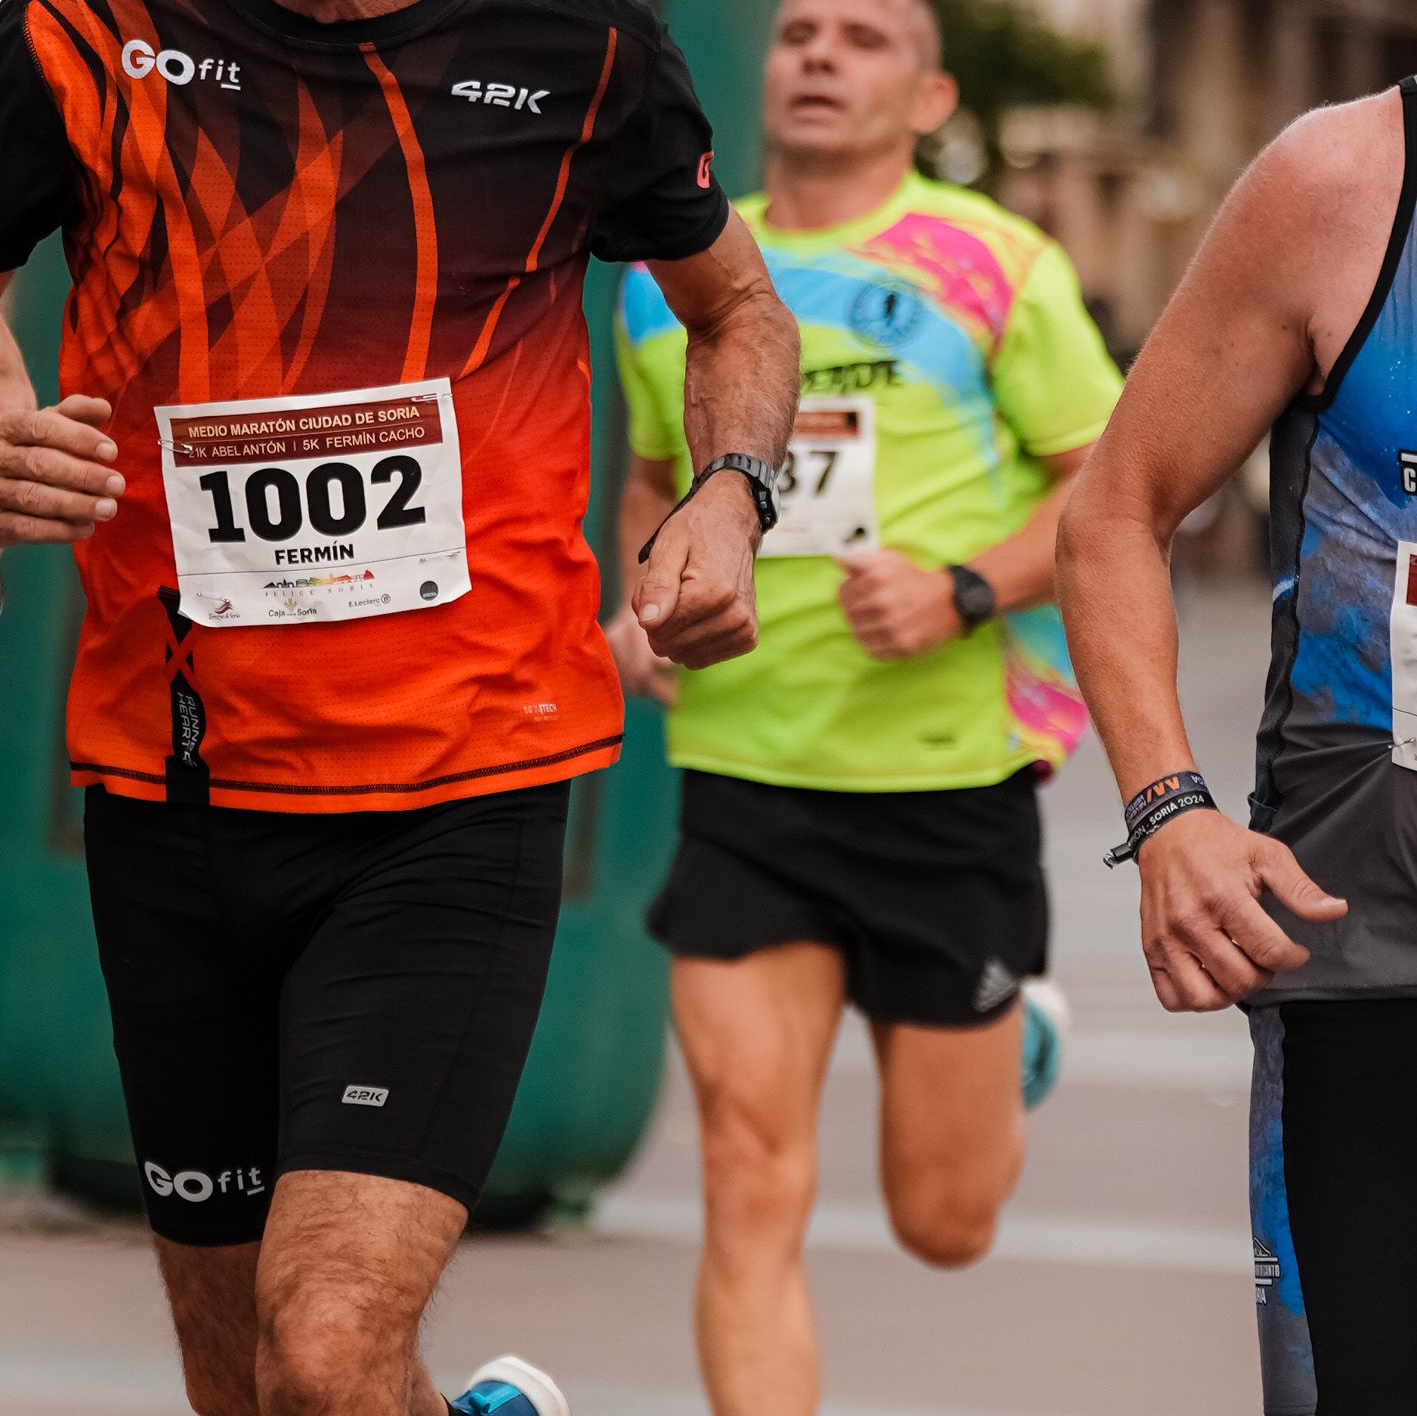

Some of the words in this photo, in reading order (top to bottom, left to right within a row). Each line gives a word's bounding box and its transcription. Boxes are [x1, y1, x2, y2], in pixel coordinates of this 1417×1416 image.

[451, 81, 551, 115] 42K
[188, 425, 229, 439] MEDIO
[230, 417, 295, 435] MARATÓN
[299, 414, 353, 431] CIUDAD
[355, 411, 373, 425] DE
[377, 405, 421, 422] SORIA
[188, 447, 208, 459] 21K
[212, 445, 242, 458] ABEL
[242, 440, 287, 456] ANTÓN
[302, 439, 320, 451] 5K
[326, 431, 377, 449] FERMÍN
[379, 426, 426, 443] CACHO
[199, 455, 426, 543] 1002
[274, 540, 355, 565] FERMÍN
[268, 609, 286, 618] Caja
[297, 608, 318, 616] Soria
[1149, 802, 1179, 825] SORIA
[1178, 795, 1205, 808] 2024
[346, 1090, 384, 1103] 42K
